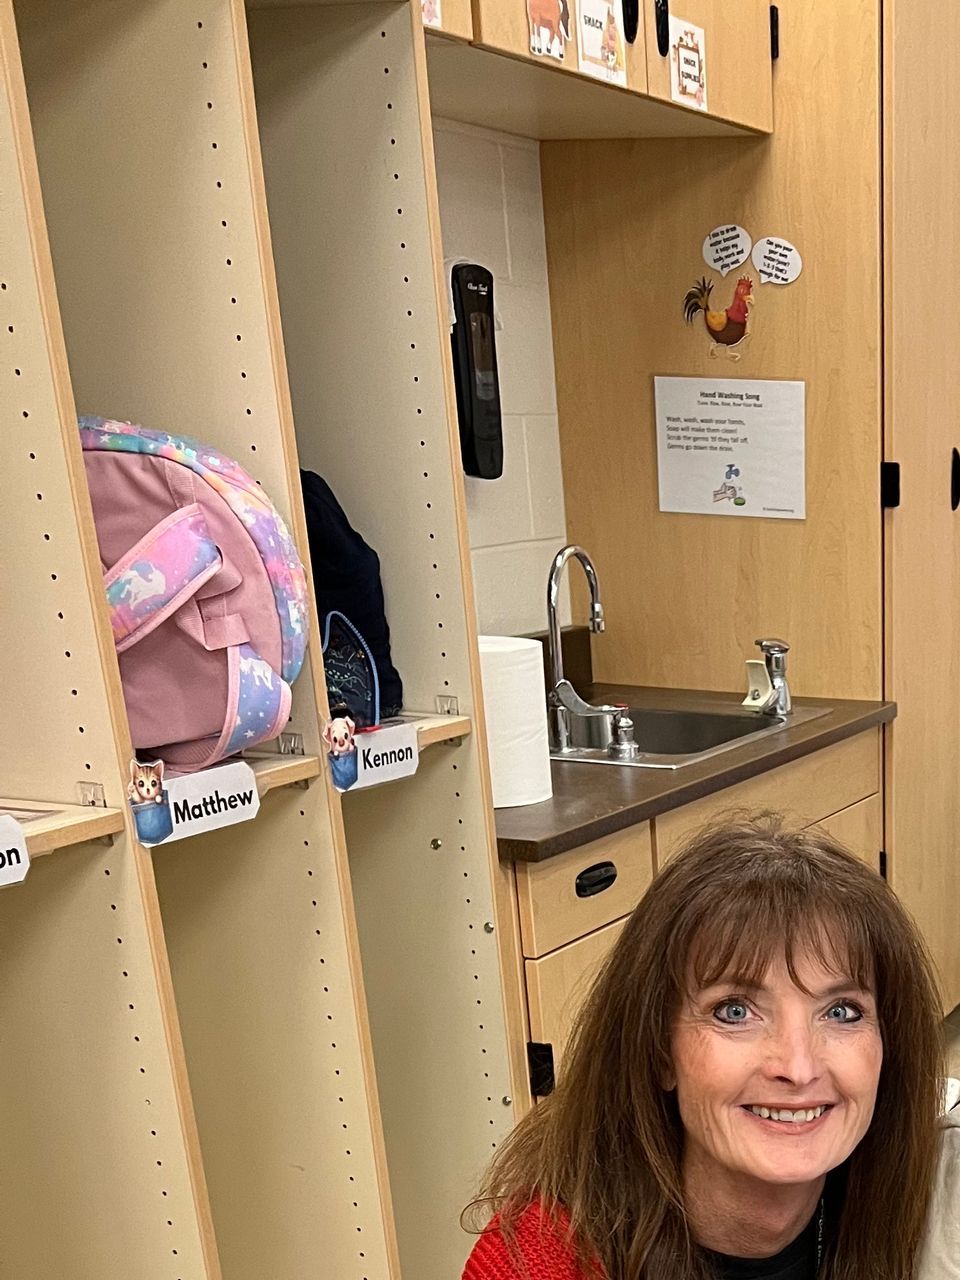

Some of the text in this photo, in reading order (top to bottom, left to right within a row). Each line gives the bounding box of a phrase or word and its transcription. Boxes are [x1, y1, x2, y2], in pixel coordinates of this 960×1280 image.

[583, 15, 603, 31] SNACK
[683, 57, 697, 67] SNACK
[718, 392, 744, 401] Washing
[745, 393, 760, 401] Song
[361, 742, 413, 771] Kennon
[173, 790, 254, 825] Matthew
